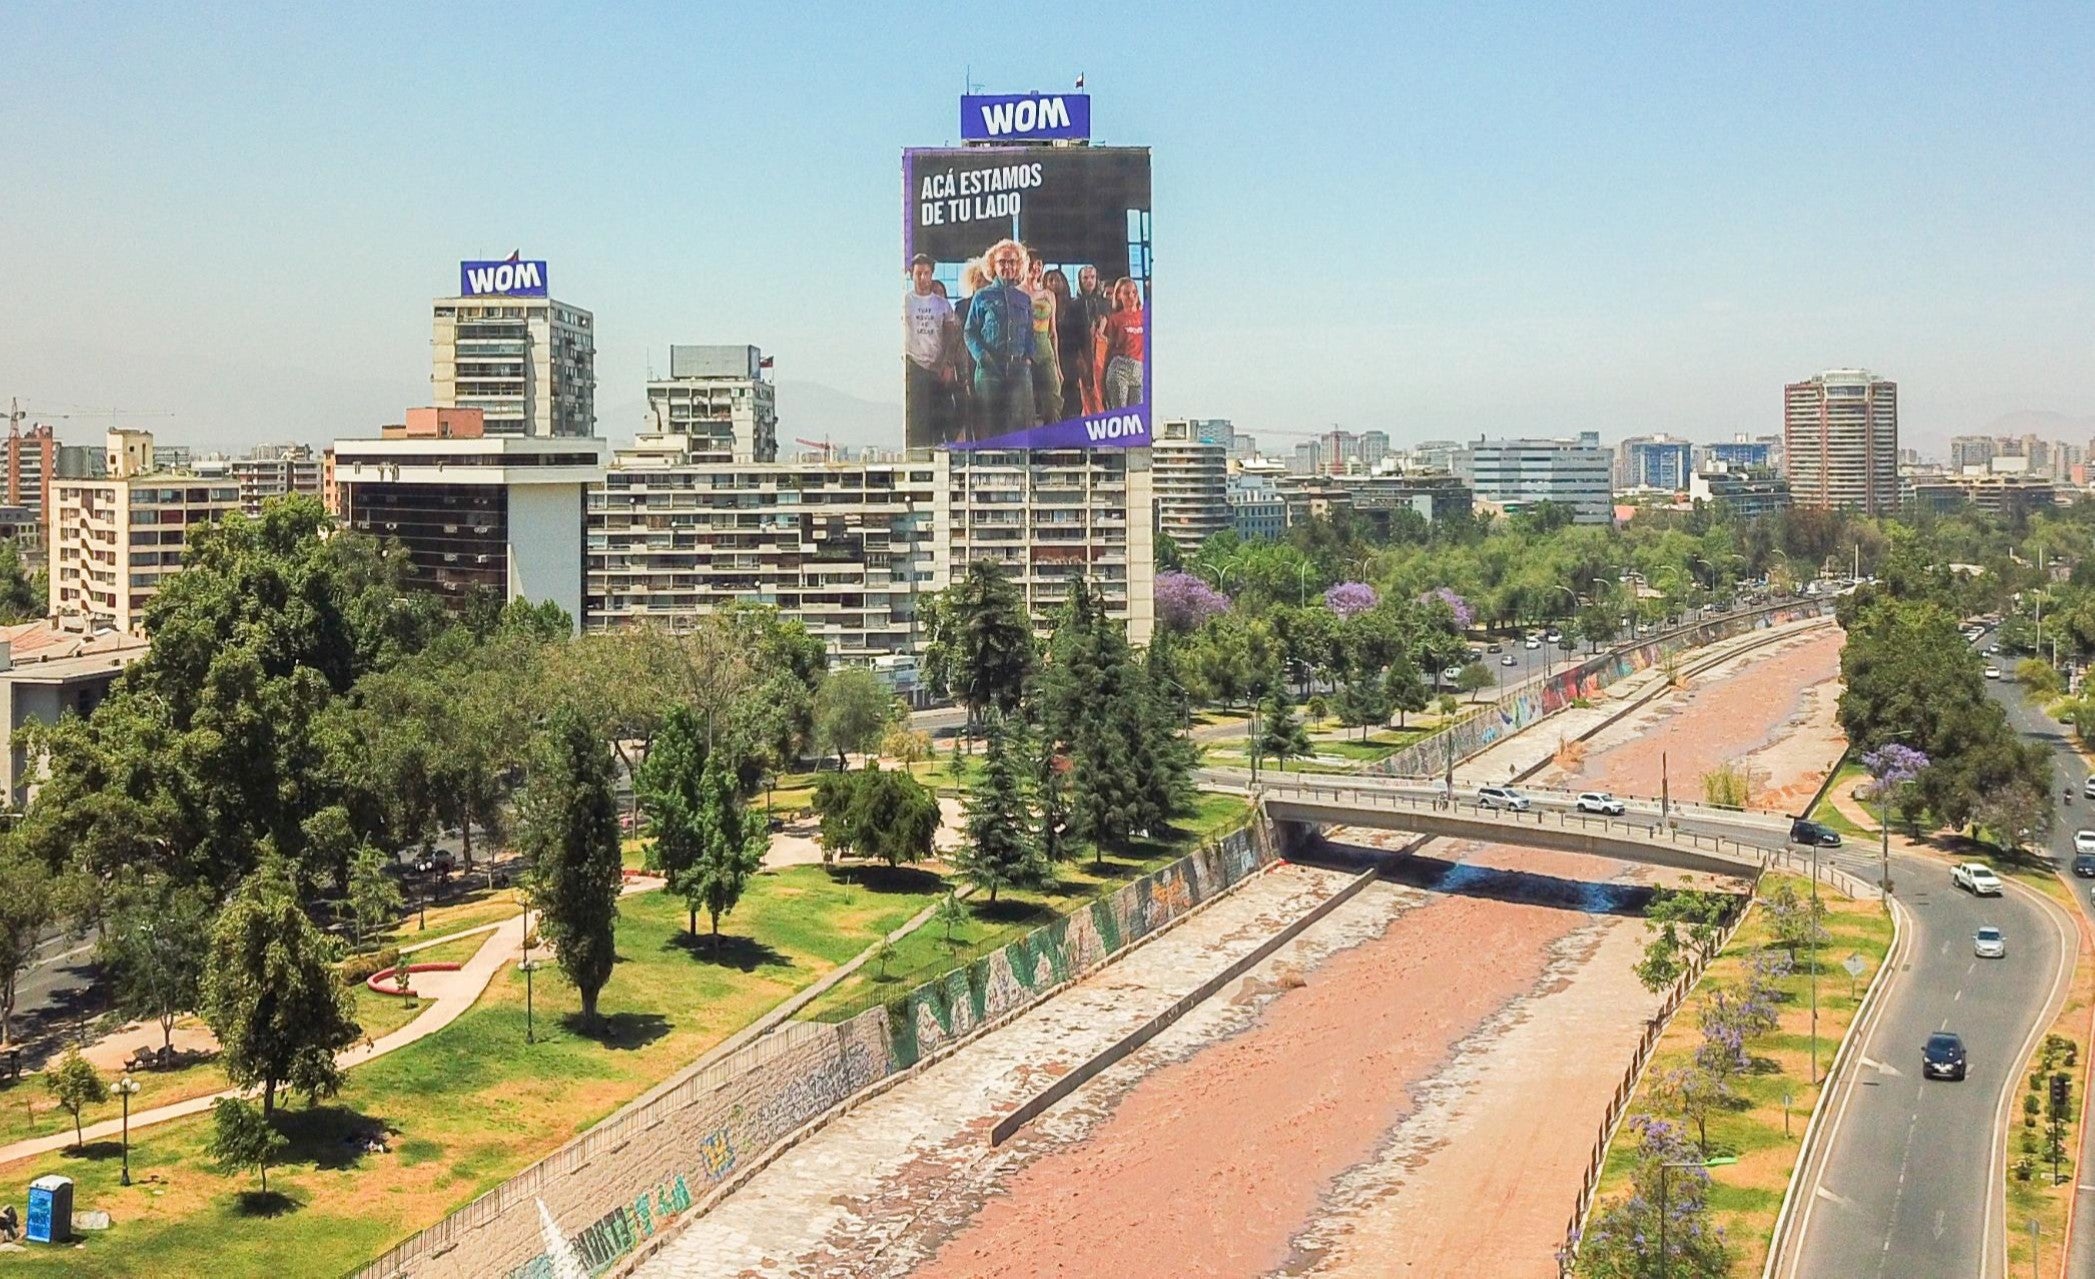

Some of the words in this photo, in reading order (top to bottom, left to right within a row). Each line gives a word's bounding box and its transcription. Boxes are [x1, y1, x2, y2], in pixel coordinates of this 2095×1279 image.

[981, 96, 1071, 136] WOM
[921, 167, 956, 200] ACÁ
[960, 163, 1042, 195] ESTAMOS
[921, 200, 944, 226] DE
[949, 198, 971, 224] TU
[975, 192, 1021, 219] LADO
[467, 262, 541, 295] WOM
[1085, 413, 1144, 441] WOM
